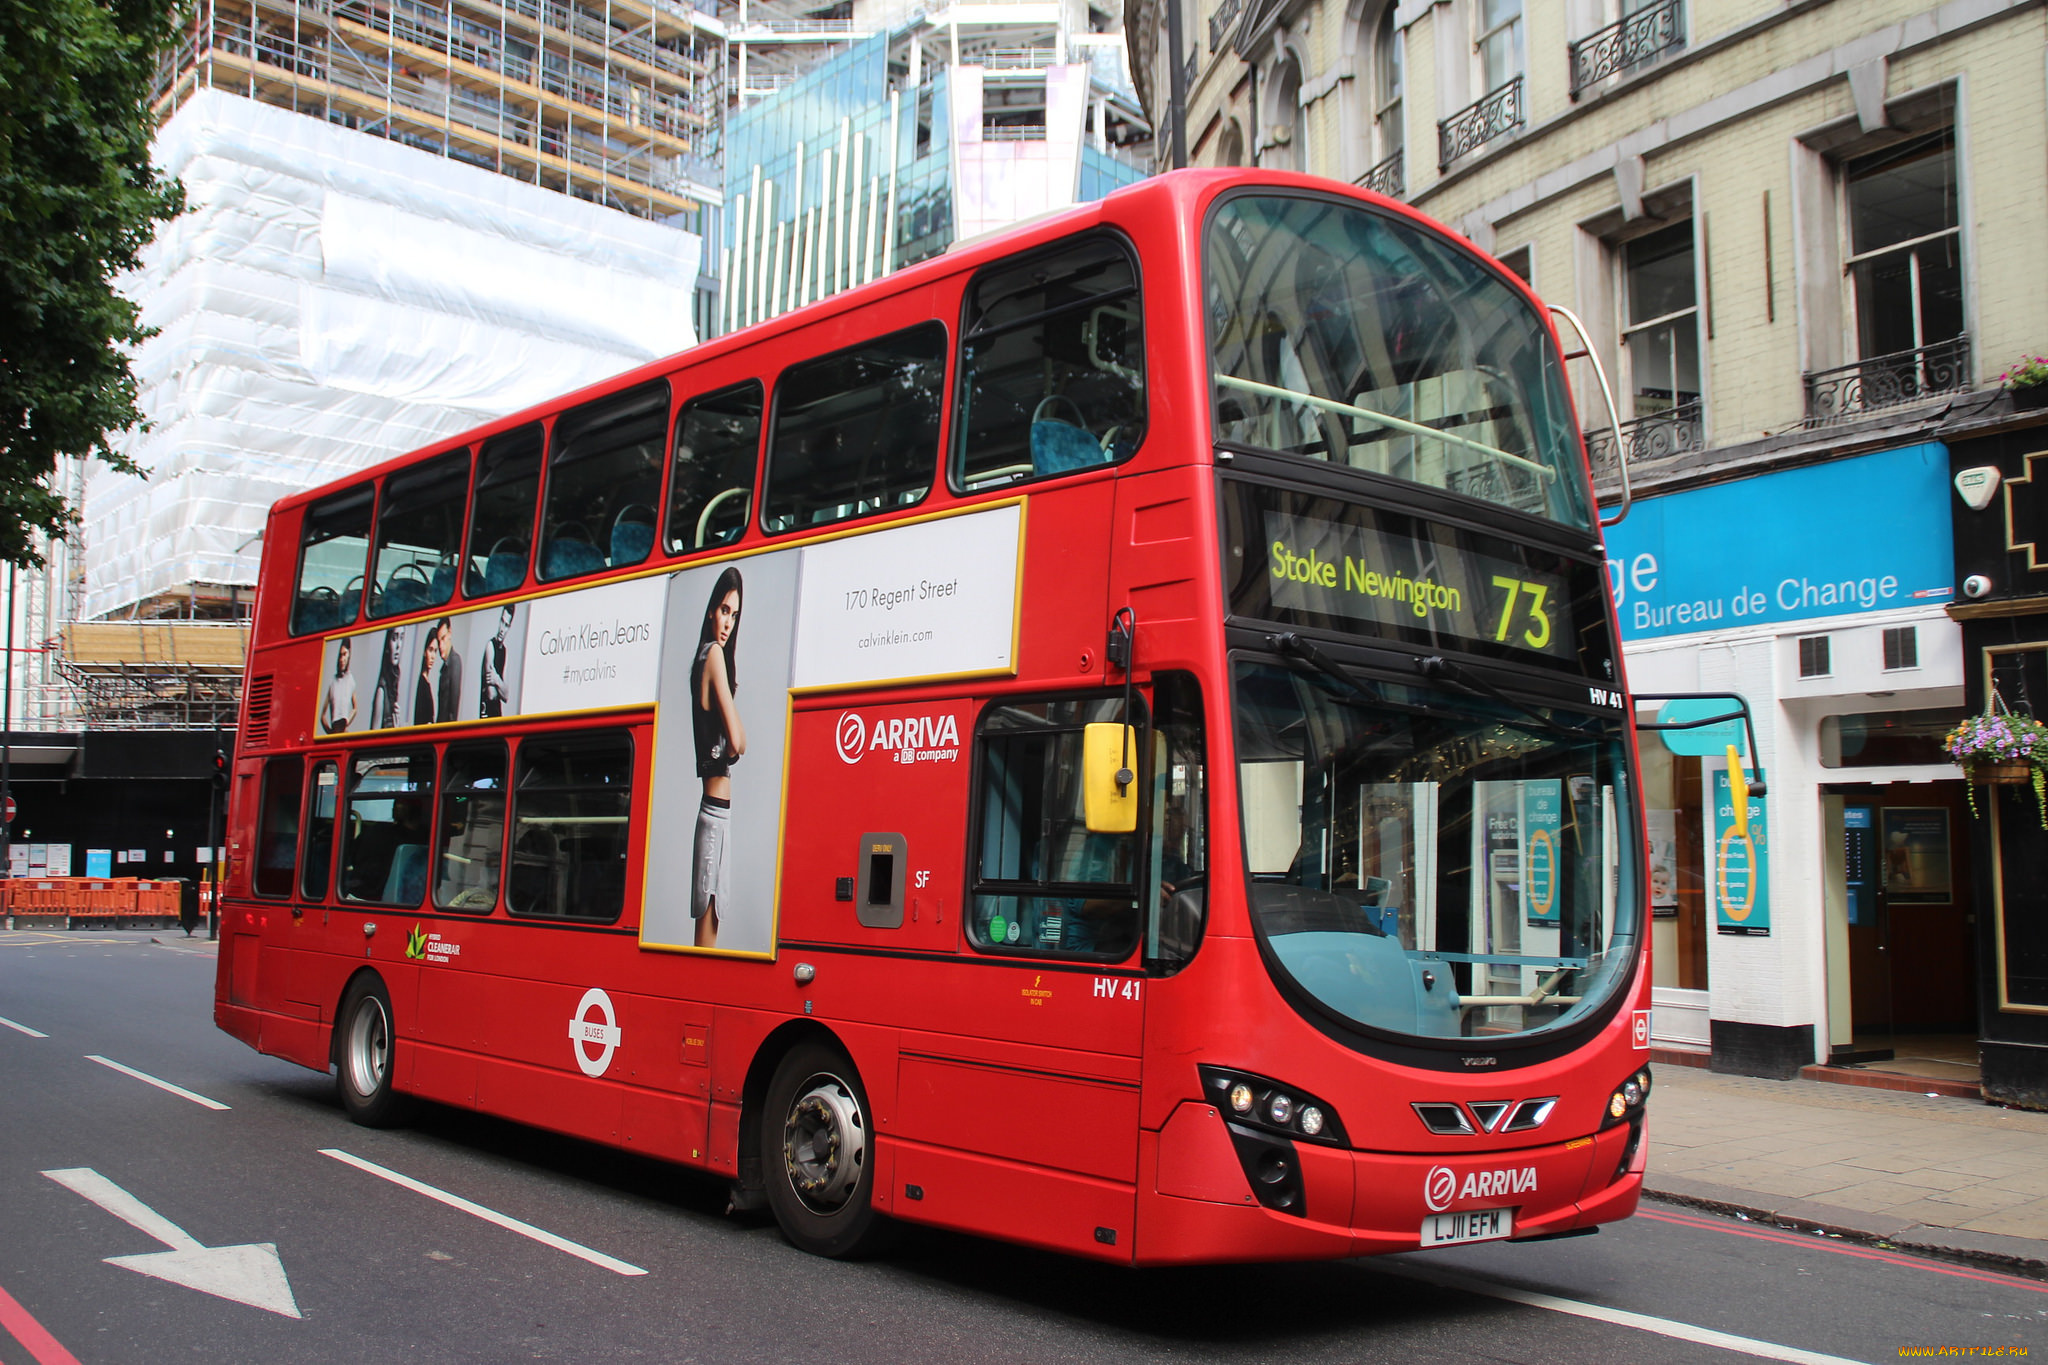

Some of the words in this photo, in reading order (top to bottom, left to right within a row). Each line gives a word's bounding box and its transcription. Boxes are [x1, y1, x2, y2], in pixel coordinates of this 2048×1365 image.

[1272, 541, 1337, 588] Stoke
[1345, 556, 1461, 617] Newington
[1605, 552, 1658, 608] ge
[845, 589, 868, 611] 170
[871, 585, 915, 610] Regent
[919, 579, 958, 600] Street
[1634, 599, 1723, 630] Bureau
[1732, 586, 1767, 616] de
[1777, 575, 1898, 611] Change
[1492, 575, 1550, 648] 73
[540, 628, 577, 656] Calvin
[579, 621, 609, 650] Klein
[609, 619, 649, 646] Jeans
[858, 630, 933, 649] calvinklein.com
[563, 659, 617, 686] #mycalvins
[1589, 687, 1607, 706] HV
[1609, 691, 1623, 709] 41
[869, 715, 959, 750] ARRIVA
[893, 752, 900, 762] a
[902, 749, 915, 763] DB
[916, 749, 959, 763] company
[1528, 811, 1558, 824] change
[1536, 799, 1549, 810] de
[1719, 804, 1761, 820] chge
[914, 870, 930, 889] SF
[1093, 977, 1119, 999] HV
[1121, 980, 1140, 1001] 41
[584, 1026, 604, 1040] BUSES
[1458, 1167, 1537, 1199] ARRIVA
[1435, 1215, 1465, 1241] LJ11
[1469, 1211, 1500, 1237] EFM
